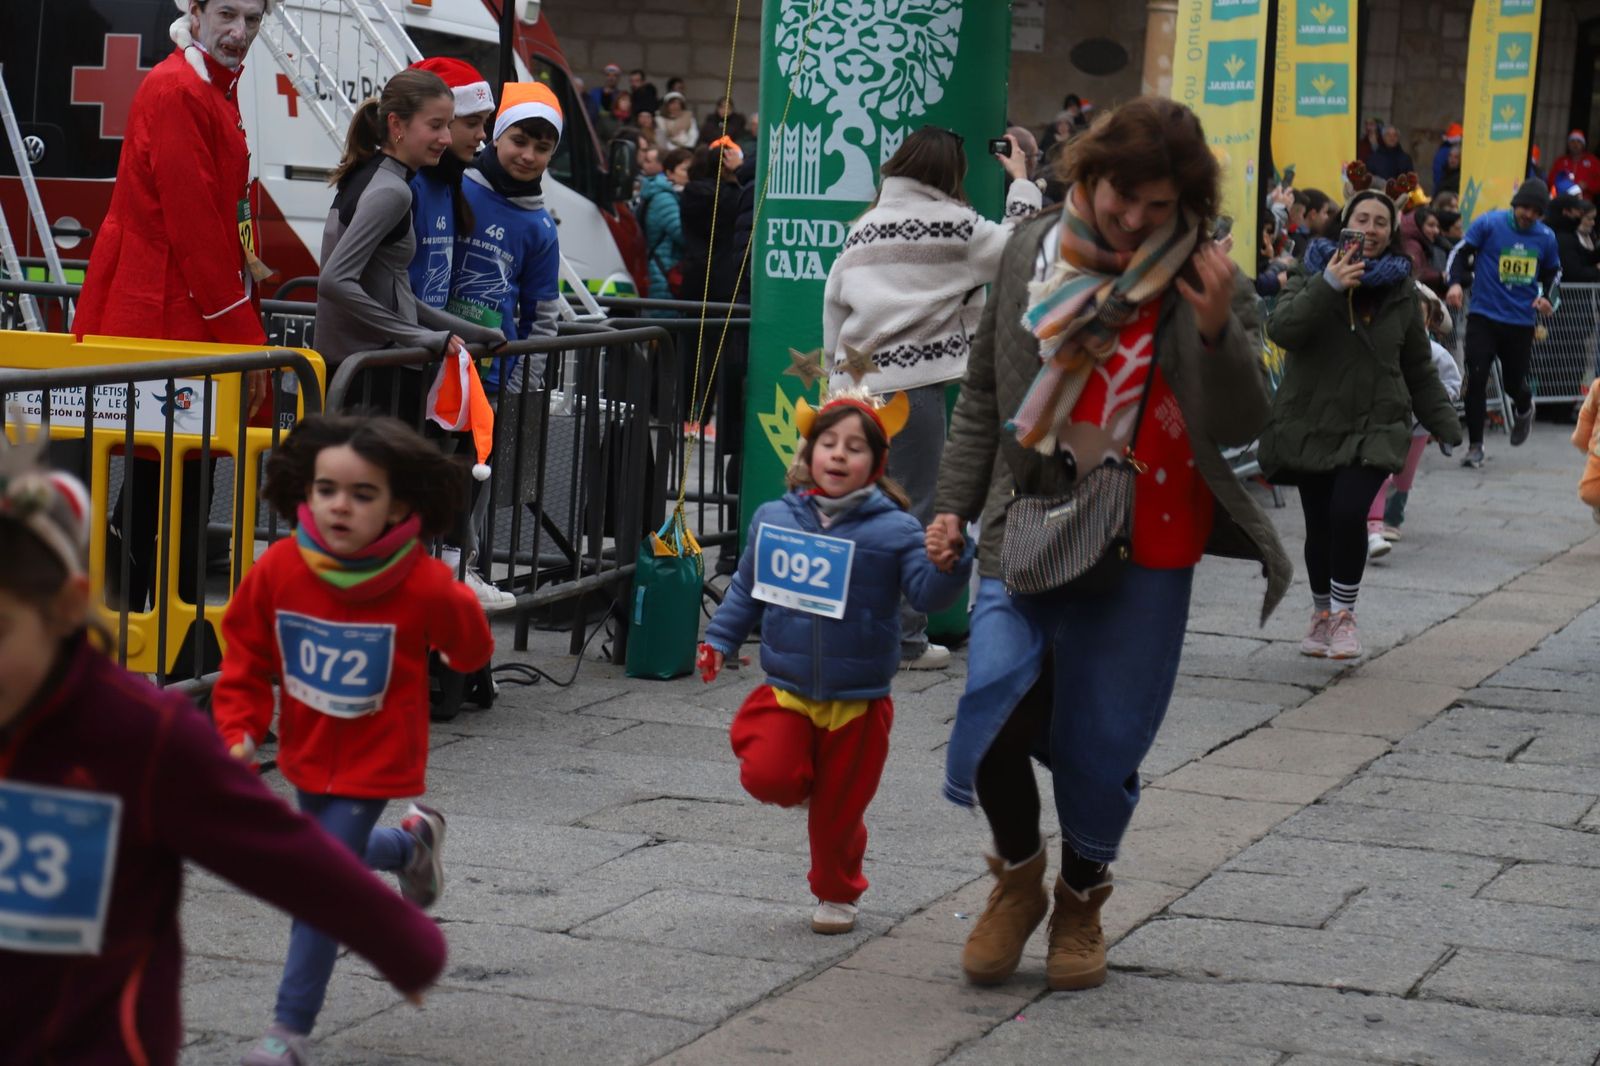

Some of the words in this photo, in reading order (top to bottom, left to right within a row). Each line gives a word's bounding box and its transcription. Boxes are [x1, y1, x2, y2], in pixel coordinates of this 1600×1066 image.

[436, 216, 446, 230] 46
[485, 224, 505, 241] 46
[766, 218, 847, 248] FUND
[765, 249, 827, 281] CAJA
[1502, 259, 1530, 276] 961
[26, 393, 85, 406] CATILLA
[93, 398, 101, 406] Y
[93, 411, 128, 420] ZAMOR
[771, 548, 831, 589] 092
[300, 638, 368, 686] 072
